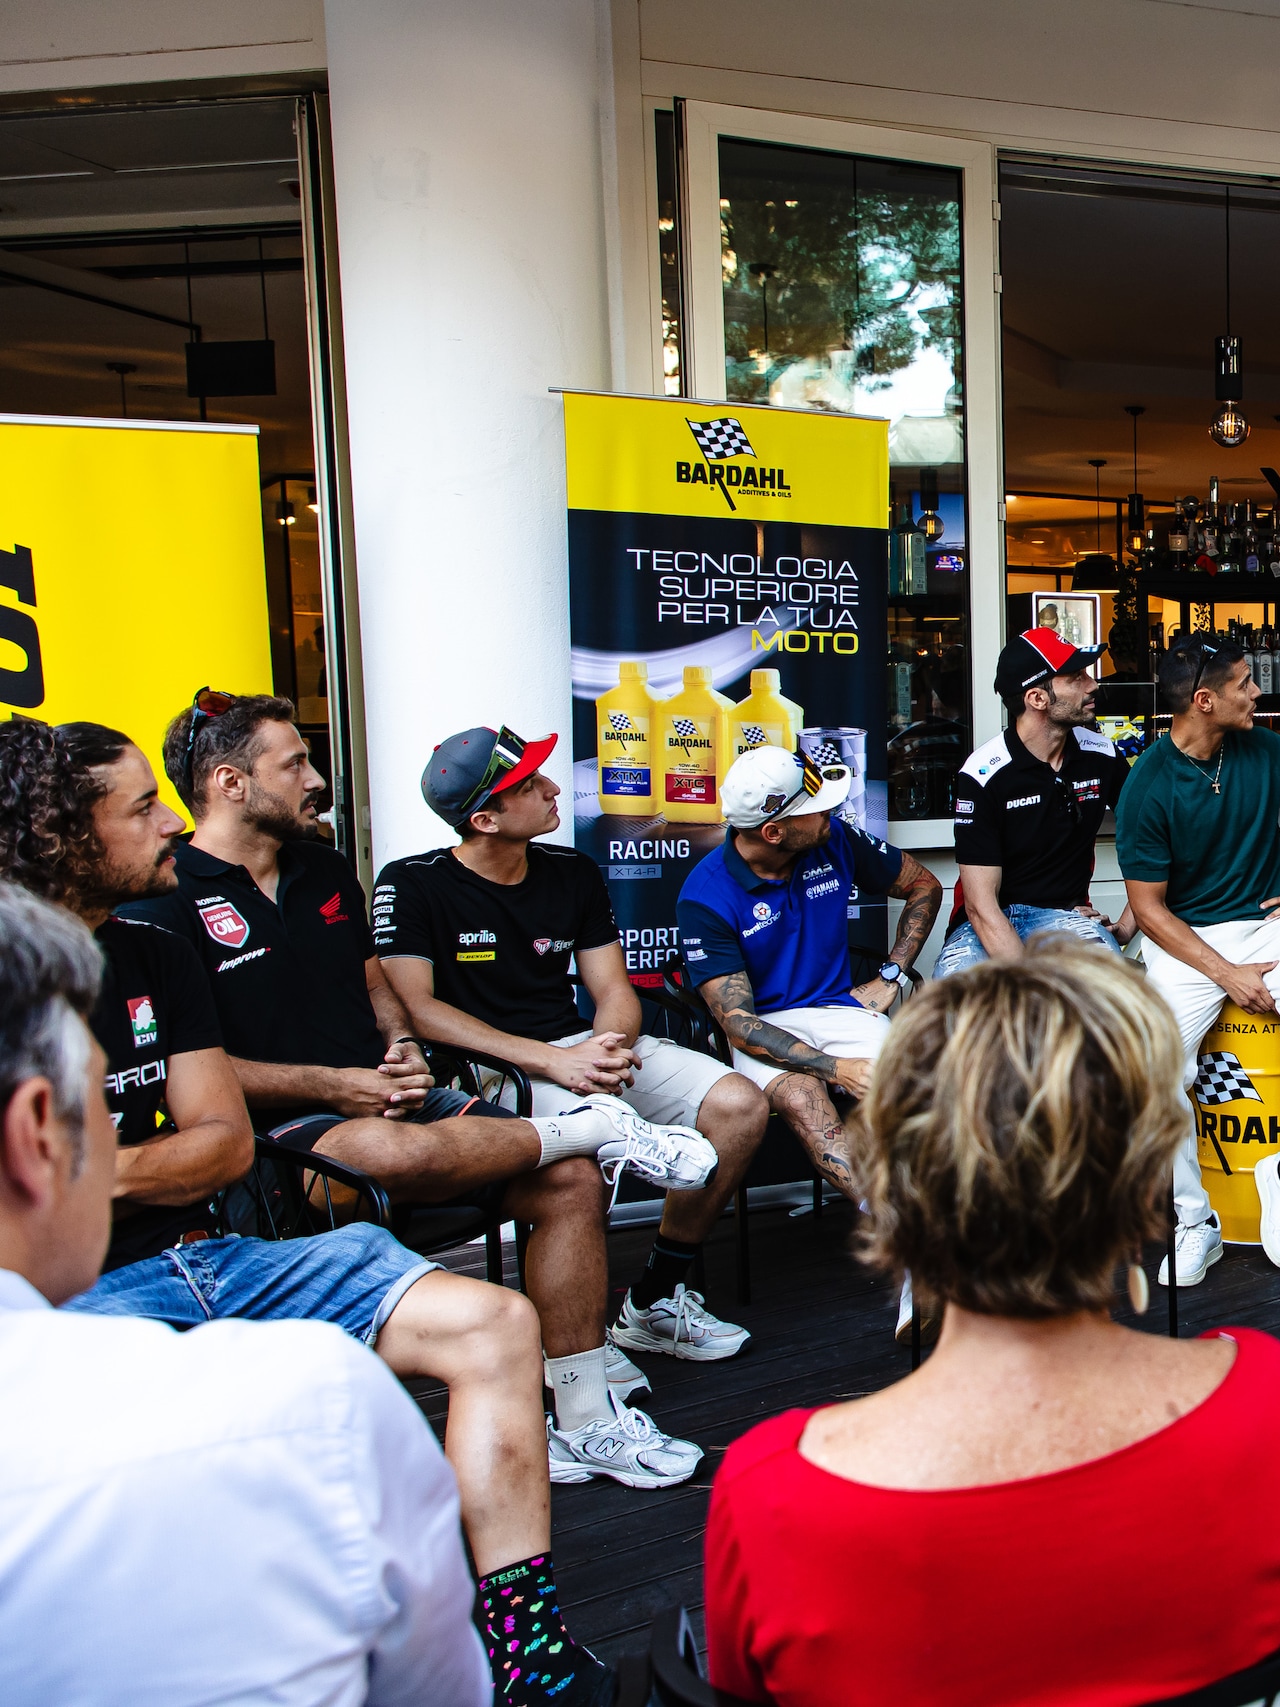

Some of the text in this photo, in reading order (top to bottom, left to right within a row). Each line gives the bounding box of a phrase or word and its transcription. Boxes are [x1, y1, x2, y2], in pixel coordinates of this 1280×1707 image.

[676, 461, 790, 490] BARDAHL
[737, 489, 770, 497] ADDITIVES
[626, 548, 858, 581] TECNOLOGIA
[659, 576, 859, 606] SUPERIORE
[658, 601, 858, 629] PER LA TUA
[751, 629, 859, 654] MOTO
[605, 732, 647, 741] BARDAHL
[669, 738, 712, 748] BARDAHL
[609, 770, 643, 781] XTM
[674, 778, 706, 788] XTC
[1006, 795, 1041, 809] DUCATI
[609, 839, 690, 860] RACING
[615, 868, 656, 876] XT4-R
[812, 879, 840, 895] YAMAHA
[213, 917, 244, 936] OIL
[459, 929, 496, 945] aprilia
[218, 947, 266, 972] improve
[1218, 1023, 1257, 1034] SENZA
[136, 1031, 158, 1046] CIV
[489, 1565, 527, 1586] TECH
